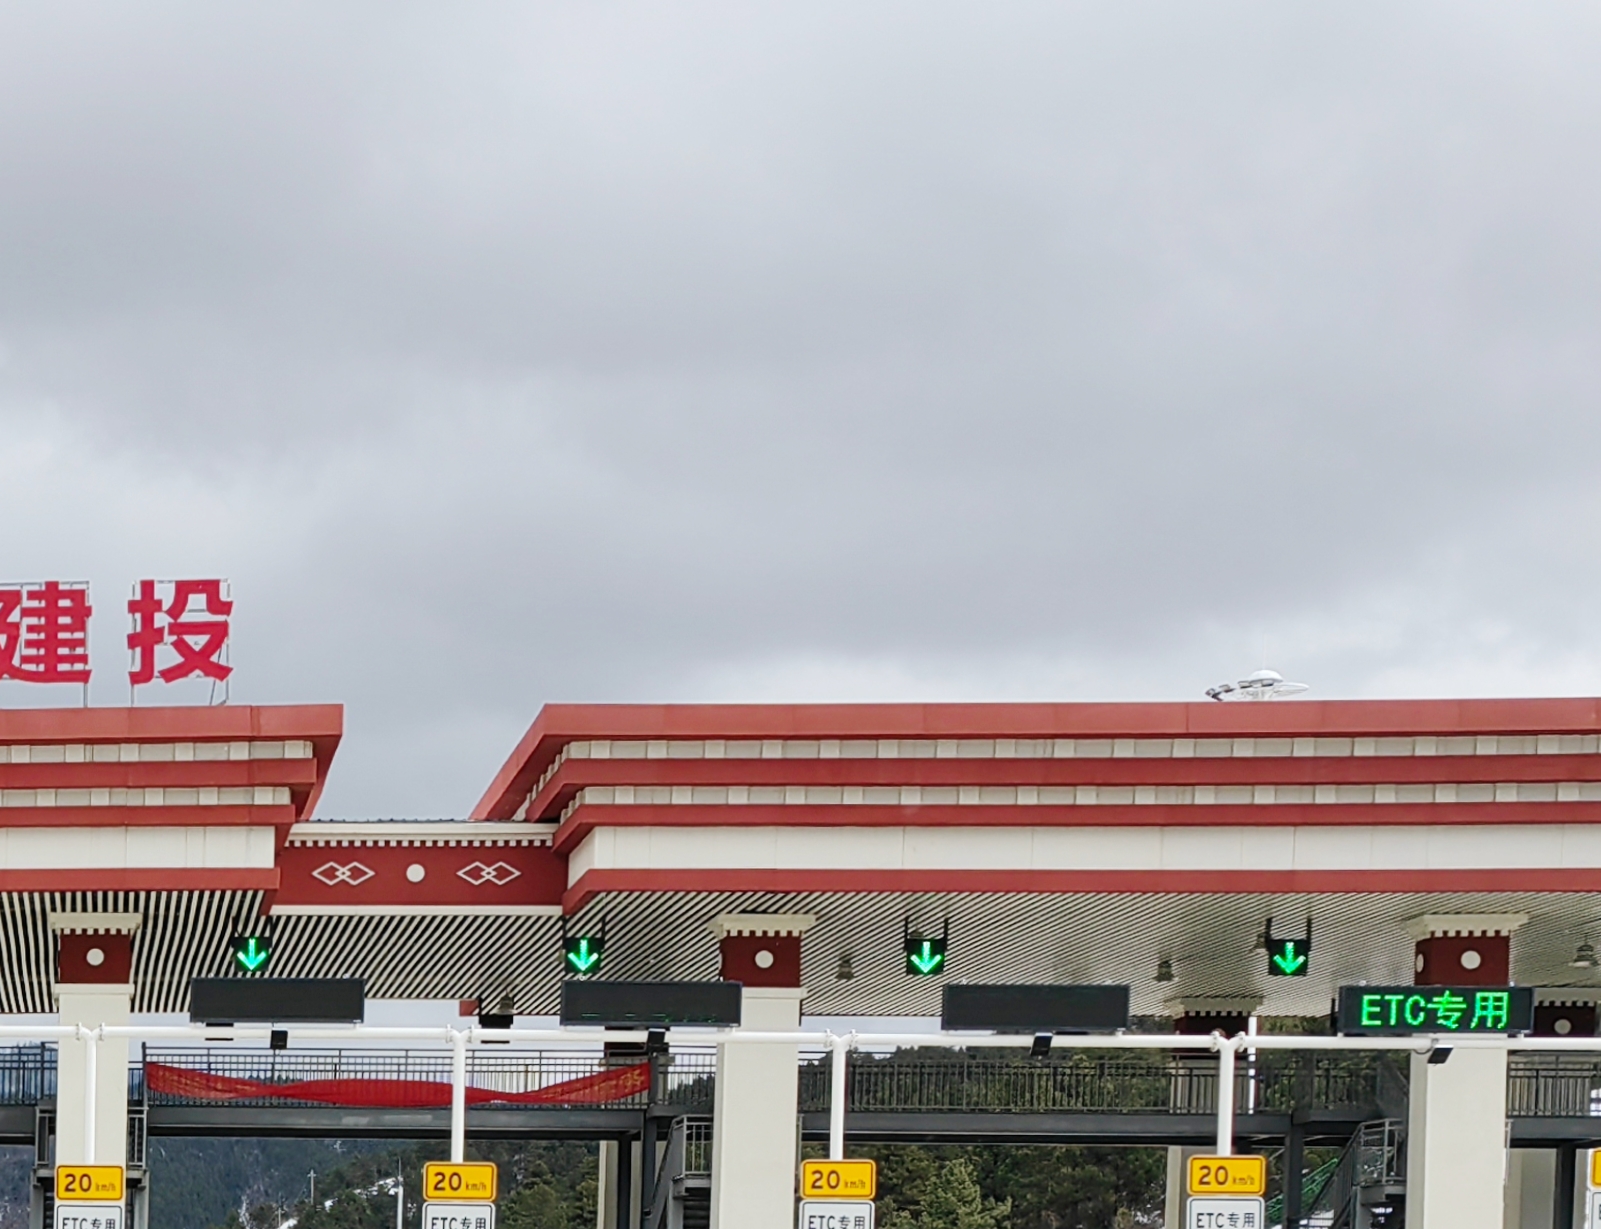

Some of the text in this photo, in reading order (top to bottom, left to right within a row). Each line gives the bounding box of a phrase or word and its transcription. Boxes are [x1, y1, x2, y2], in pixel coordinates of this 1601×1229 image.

[1360, 989, 1509, 1030] ETC专用
[64, 1173, 92, 1193] 20
[433, 1172, 487, 1192] 20 km/h
[811, 1170, 840, 1190] 20
[1198, 1165, 1229, 1186] 20
[1196, 1212, 1255, 1229] ETC专用
